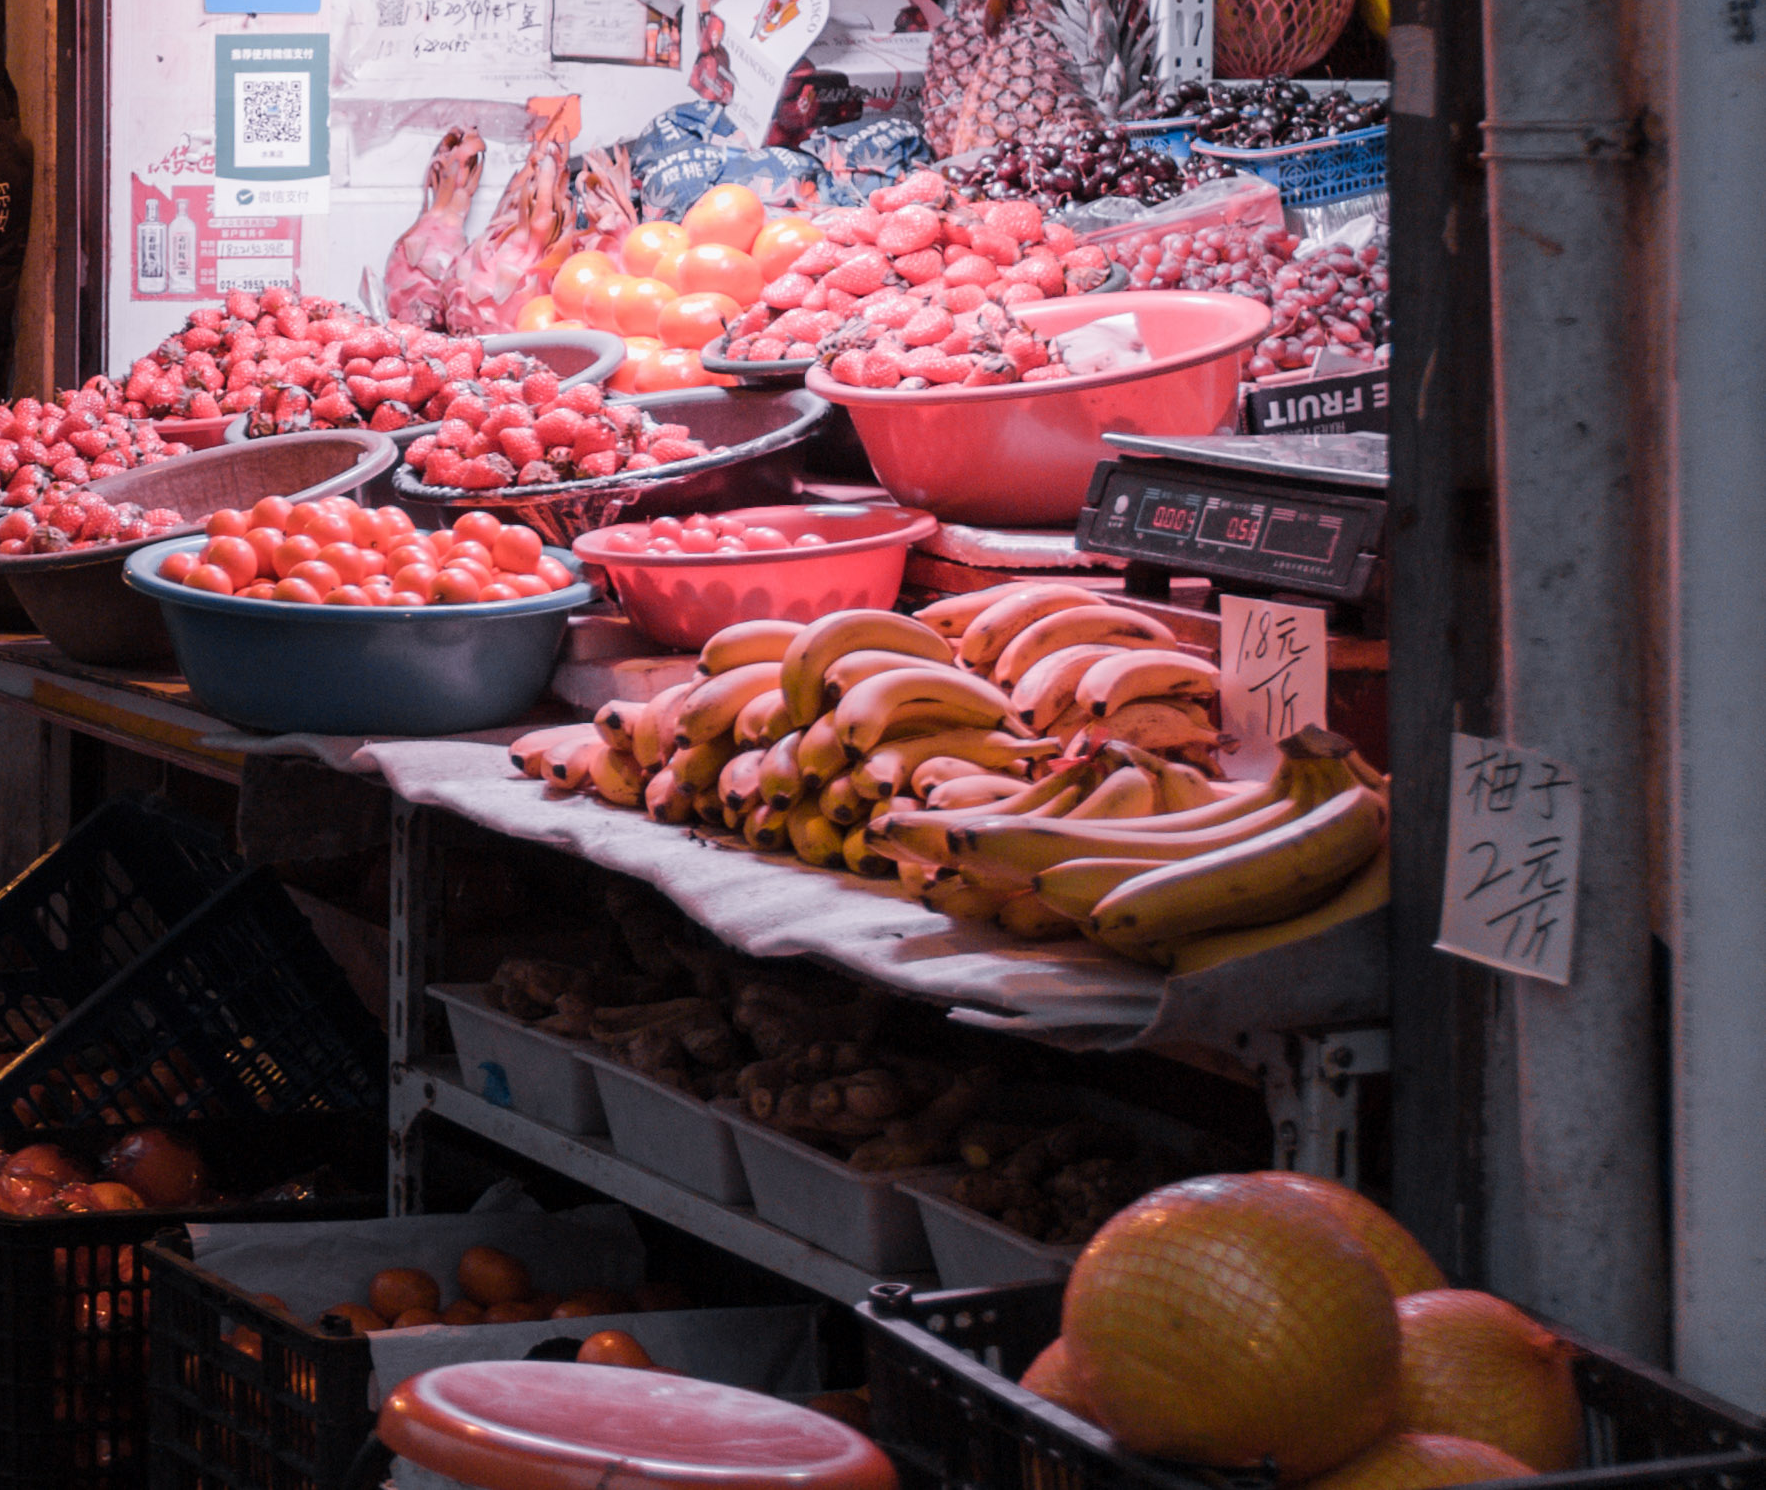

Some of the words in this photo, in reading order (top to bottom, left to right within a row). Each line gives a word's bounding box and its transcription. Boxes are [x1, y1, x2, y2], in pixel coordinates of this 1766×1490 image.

[258, 190, 309, 204] 微信支付
[1264, 386, 1363, 428] FRUIT
[1466, 741, 1573, 820] 柚子
